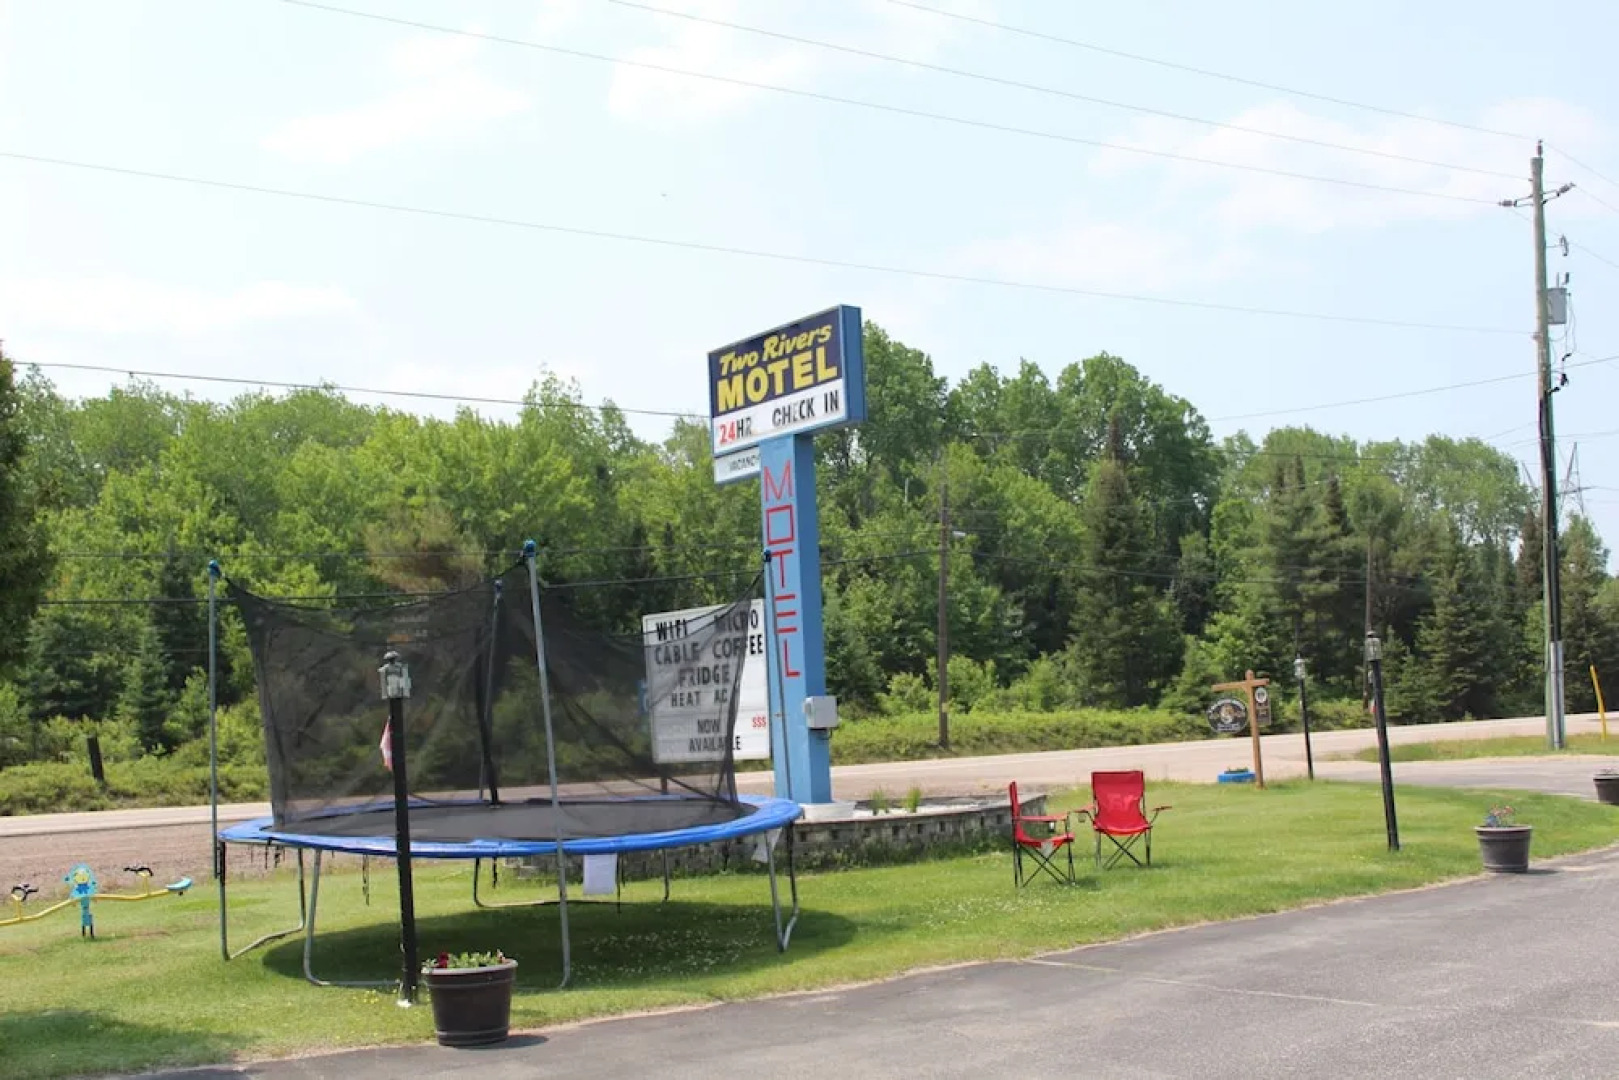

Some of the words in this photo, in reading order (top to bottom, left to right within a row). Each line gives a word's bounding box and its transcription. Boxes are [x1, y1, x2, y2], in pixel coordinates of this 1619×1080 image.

[719, 351, 758, 376] Two
[763, 325, 832, 362] Rivers
[717, 347, 838, 412] MOTEL
[772, 397, 815, 427] CHECK
[824, 390, 840, 414] IN
[764, 459, 801, 678] MOTEL
[656, 618, 687, 641] WIFI
[655, 642, 700, 665] CABLE
[678, 664, 730, 688] FRIDGE
[671, 691, 700, 707] HEAT
[714, 688, 728, 704] AC
[697, 719, 720, 734] NOW
[689, 735, 742, 752] AVAILAE
